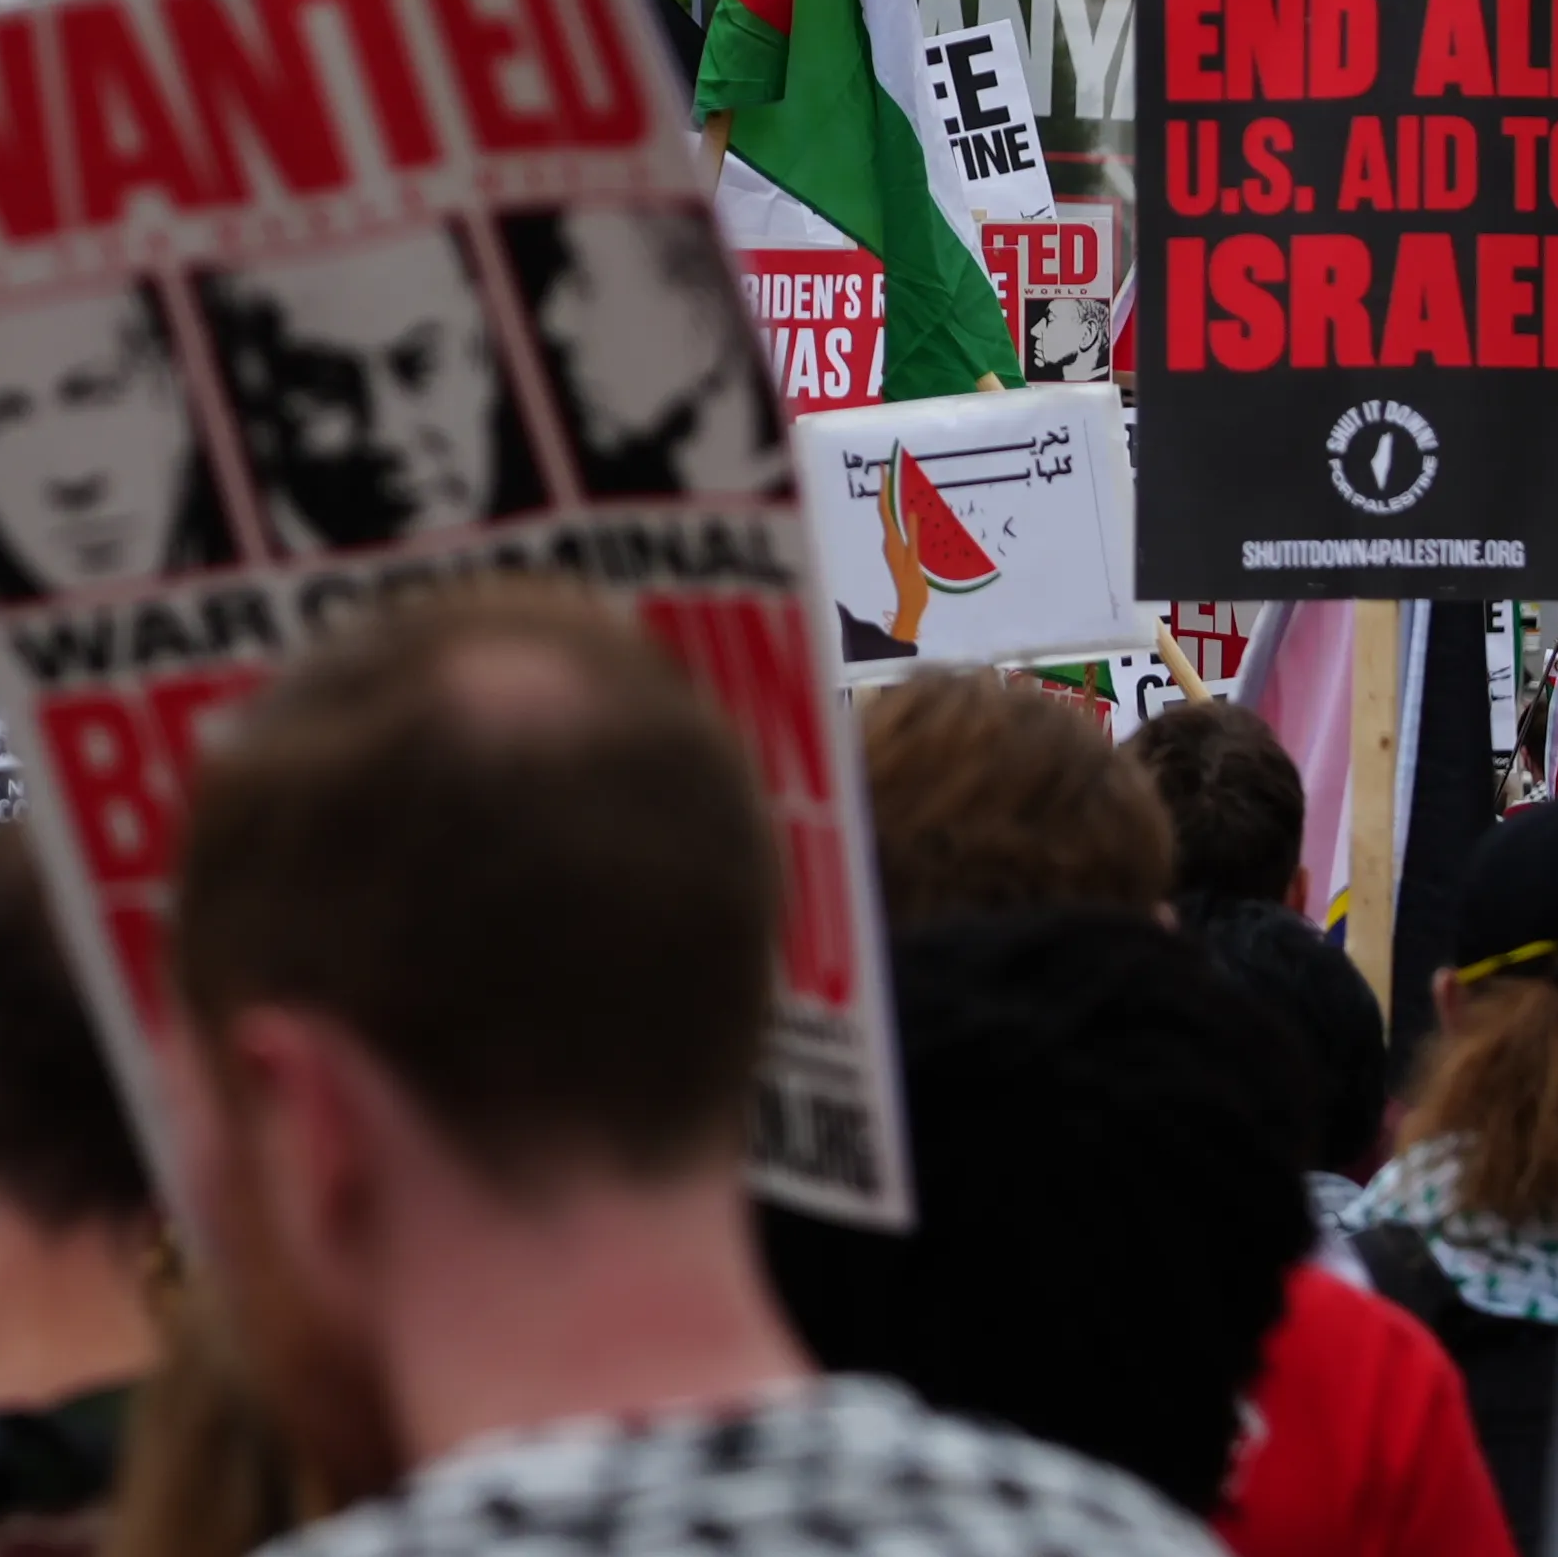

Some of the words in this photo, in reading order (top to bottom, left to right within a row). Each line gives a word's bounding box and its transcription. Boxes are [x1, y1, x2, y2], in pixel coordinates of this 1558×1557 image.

[1166, 118, 1313, 217] U.S.
[1338, 116, 1478, 214] AID
[1326, 405, 1364, 454] SHUT
[1362, 399, 1382, 423] IT
[1328, 457, 1354, 501] FOR
[1351, 454, 1439, 515] PALESTINE
[1242, 538, 1526, 570] SHUTITDOWN4PALESTINE.ORG
[10, 572, 278, 681] WAR
